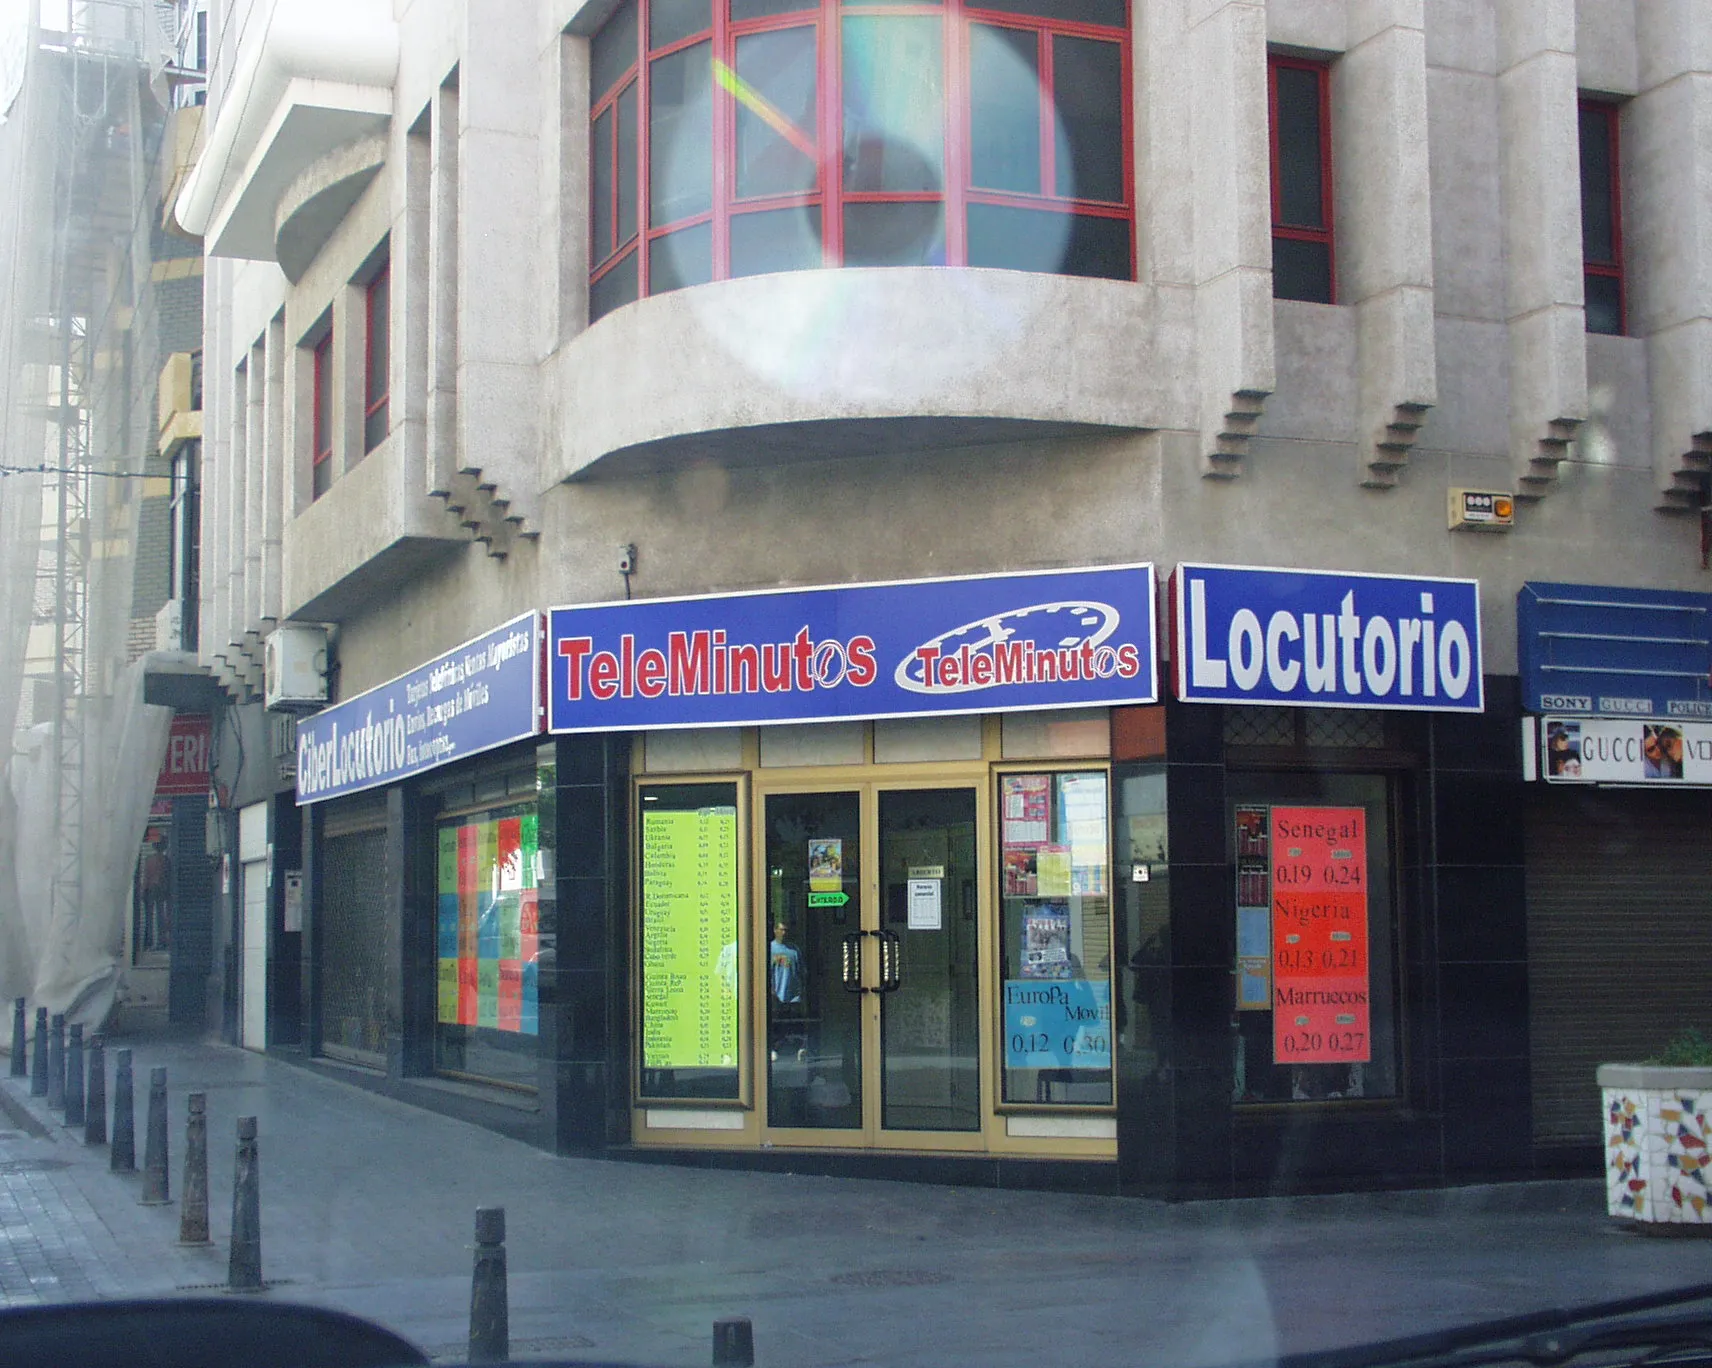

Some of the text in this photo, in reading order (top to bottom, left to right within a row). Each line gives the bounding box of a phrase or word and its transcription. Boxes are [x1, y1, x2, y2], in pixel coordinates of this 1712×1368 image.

[1190, 579, 1471, 700] Locutorio
[558, 624, 877, 701] TeleMinutos
[915, 639, 1140, 687] TeleMinutos
[1542, 696, 1712, 715] SONY GUCCI POLICE
[298, 698, 406, 796] CiberLocutorio
[1582, 735, 1644, 762] GUCCI
[1278, 819, 1358, 846] Senegal
[1275, 898, 1350, 927] Nigeria
[1276, 987, 1367, 1006] Marruecos
[1012, 1033, 1106, 1056] 0,12 0,30
